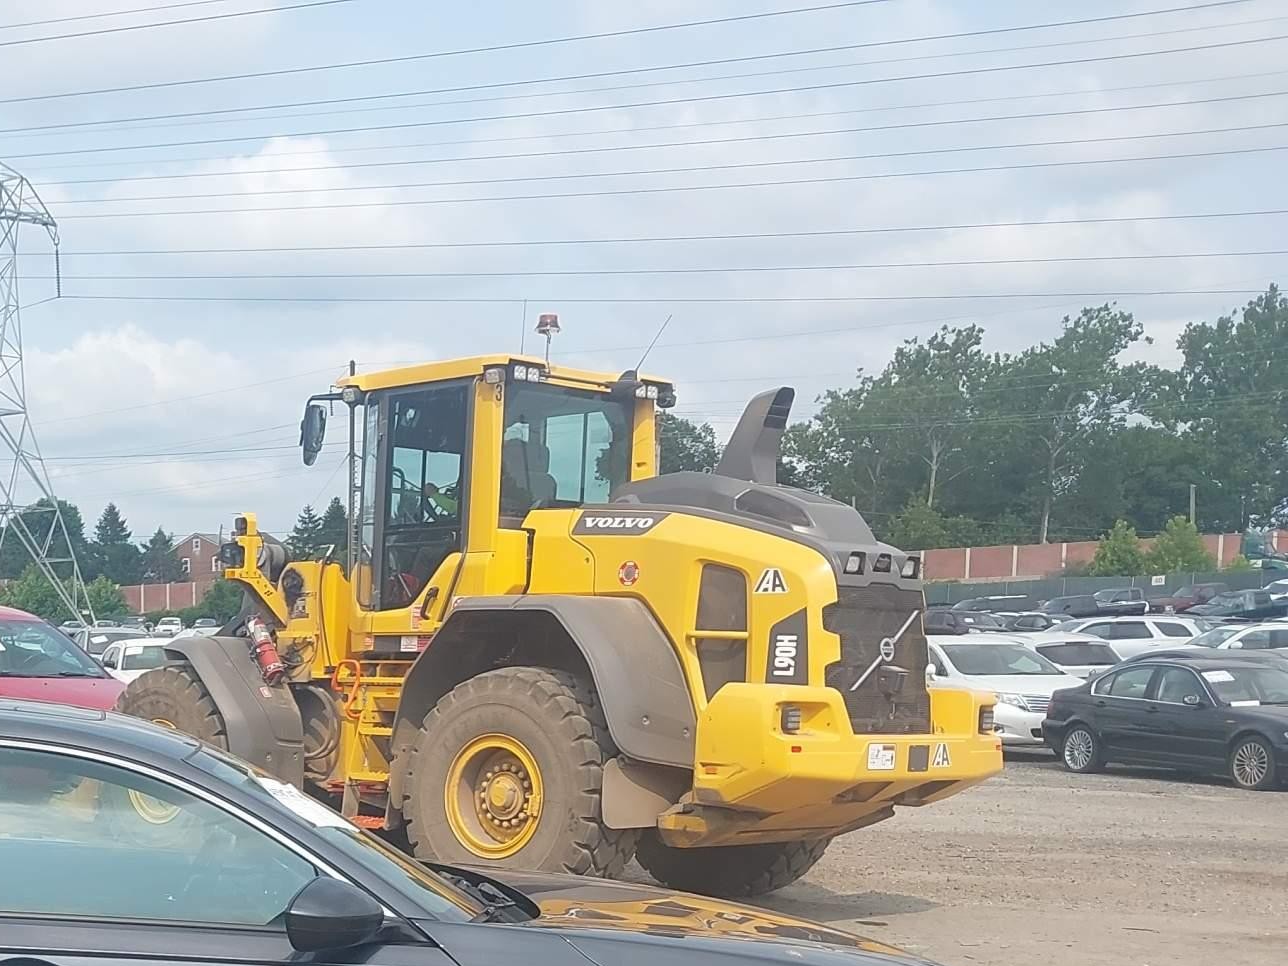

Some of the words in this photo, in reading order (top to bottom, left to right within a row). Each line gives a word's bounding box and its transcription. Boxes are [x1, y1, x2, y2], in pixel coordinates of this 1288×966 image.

[495, 384, 503, 402] 3
[584, 517, 654, 529] VOLVO
[773, 635, 798, 676] L90H
